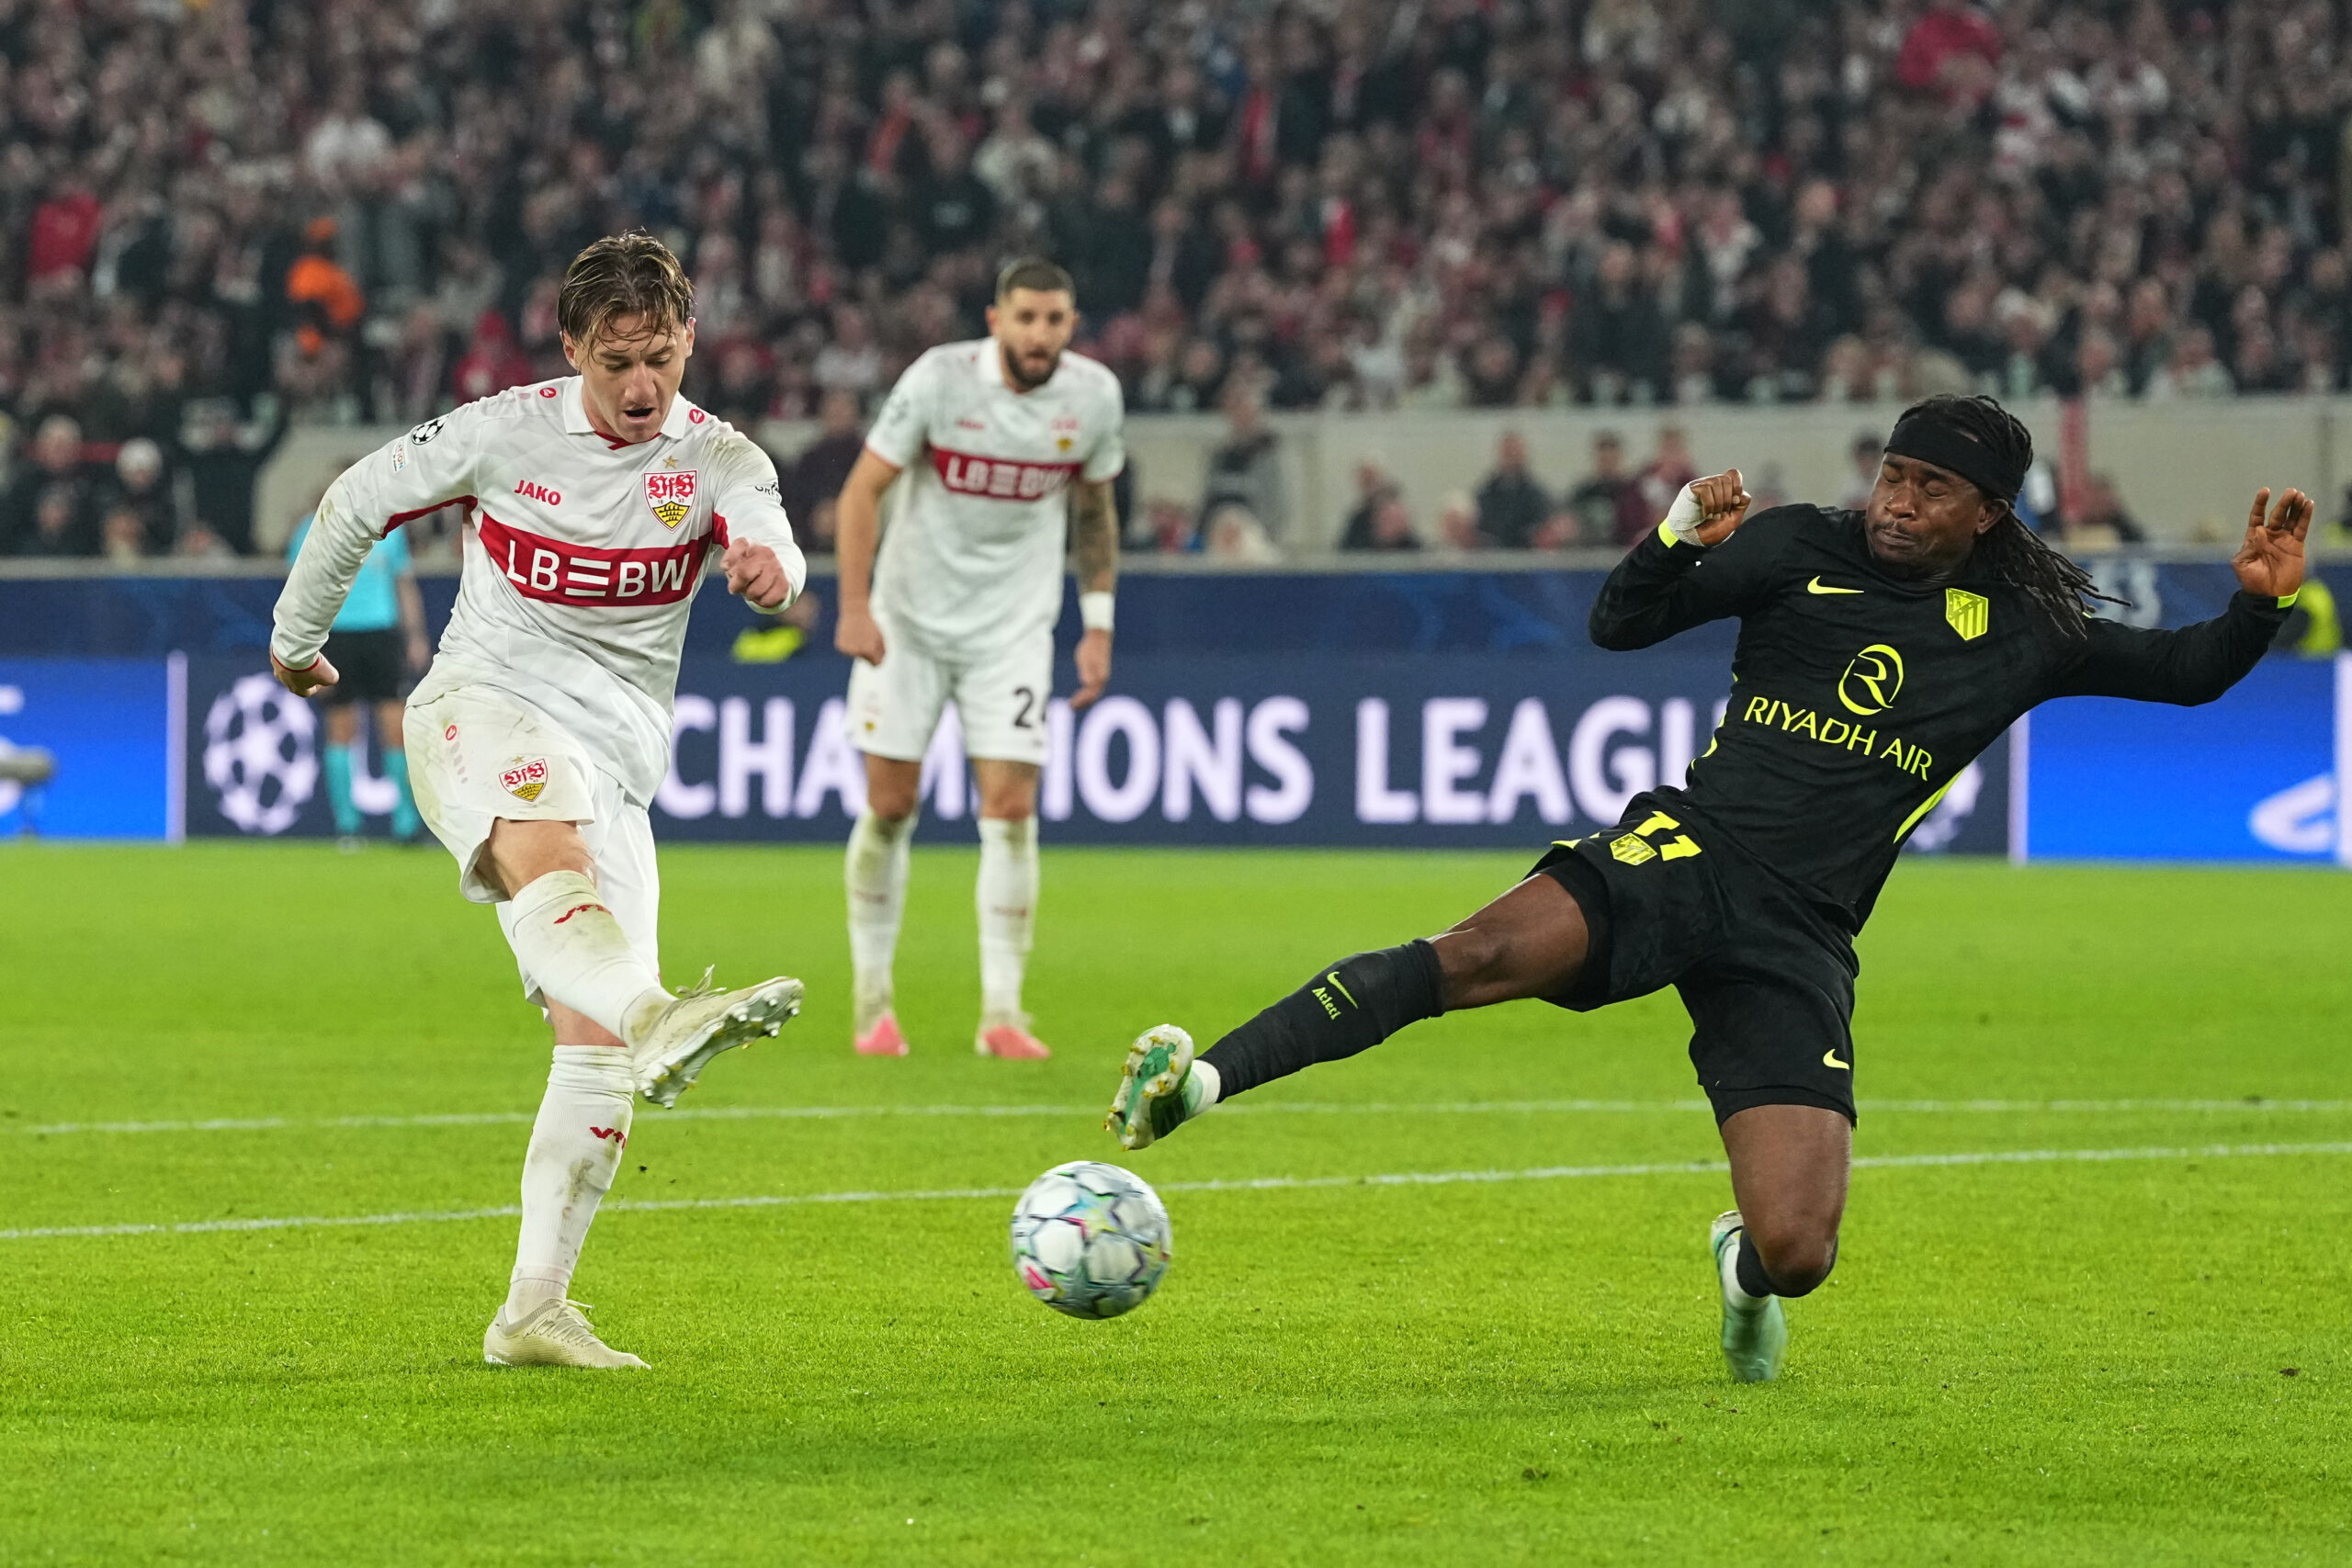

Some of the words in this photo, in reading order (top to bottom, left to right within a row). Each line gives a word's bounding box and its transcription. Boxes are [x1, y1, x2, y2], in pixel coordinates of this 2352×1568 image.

[514, 479, 561, 505] JAKO
[655, 694, 1315, 823] CHAMIONS
[1744, 696, 1877, 756] RIYADH
[1880, 738, 1932, 781] AIR
